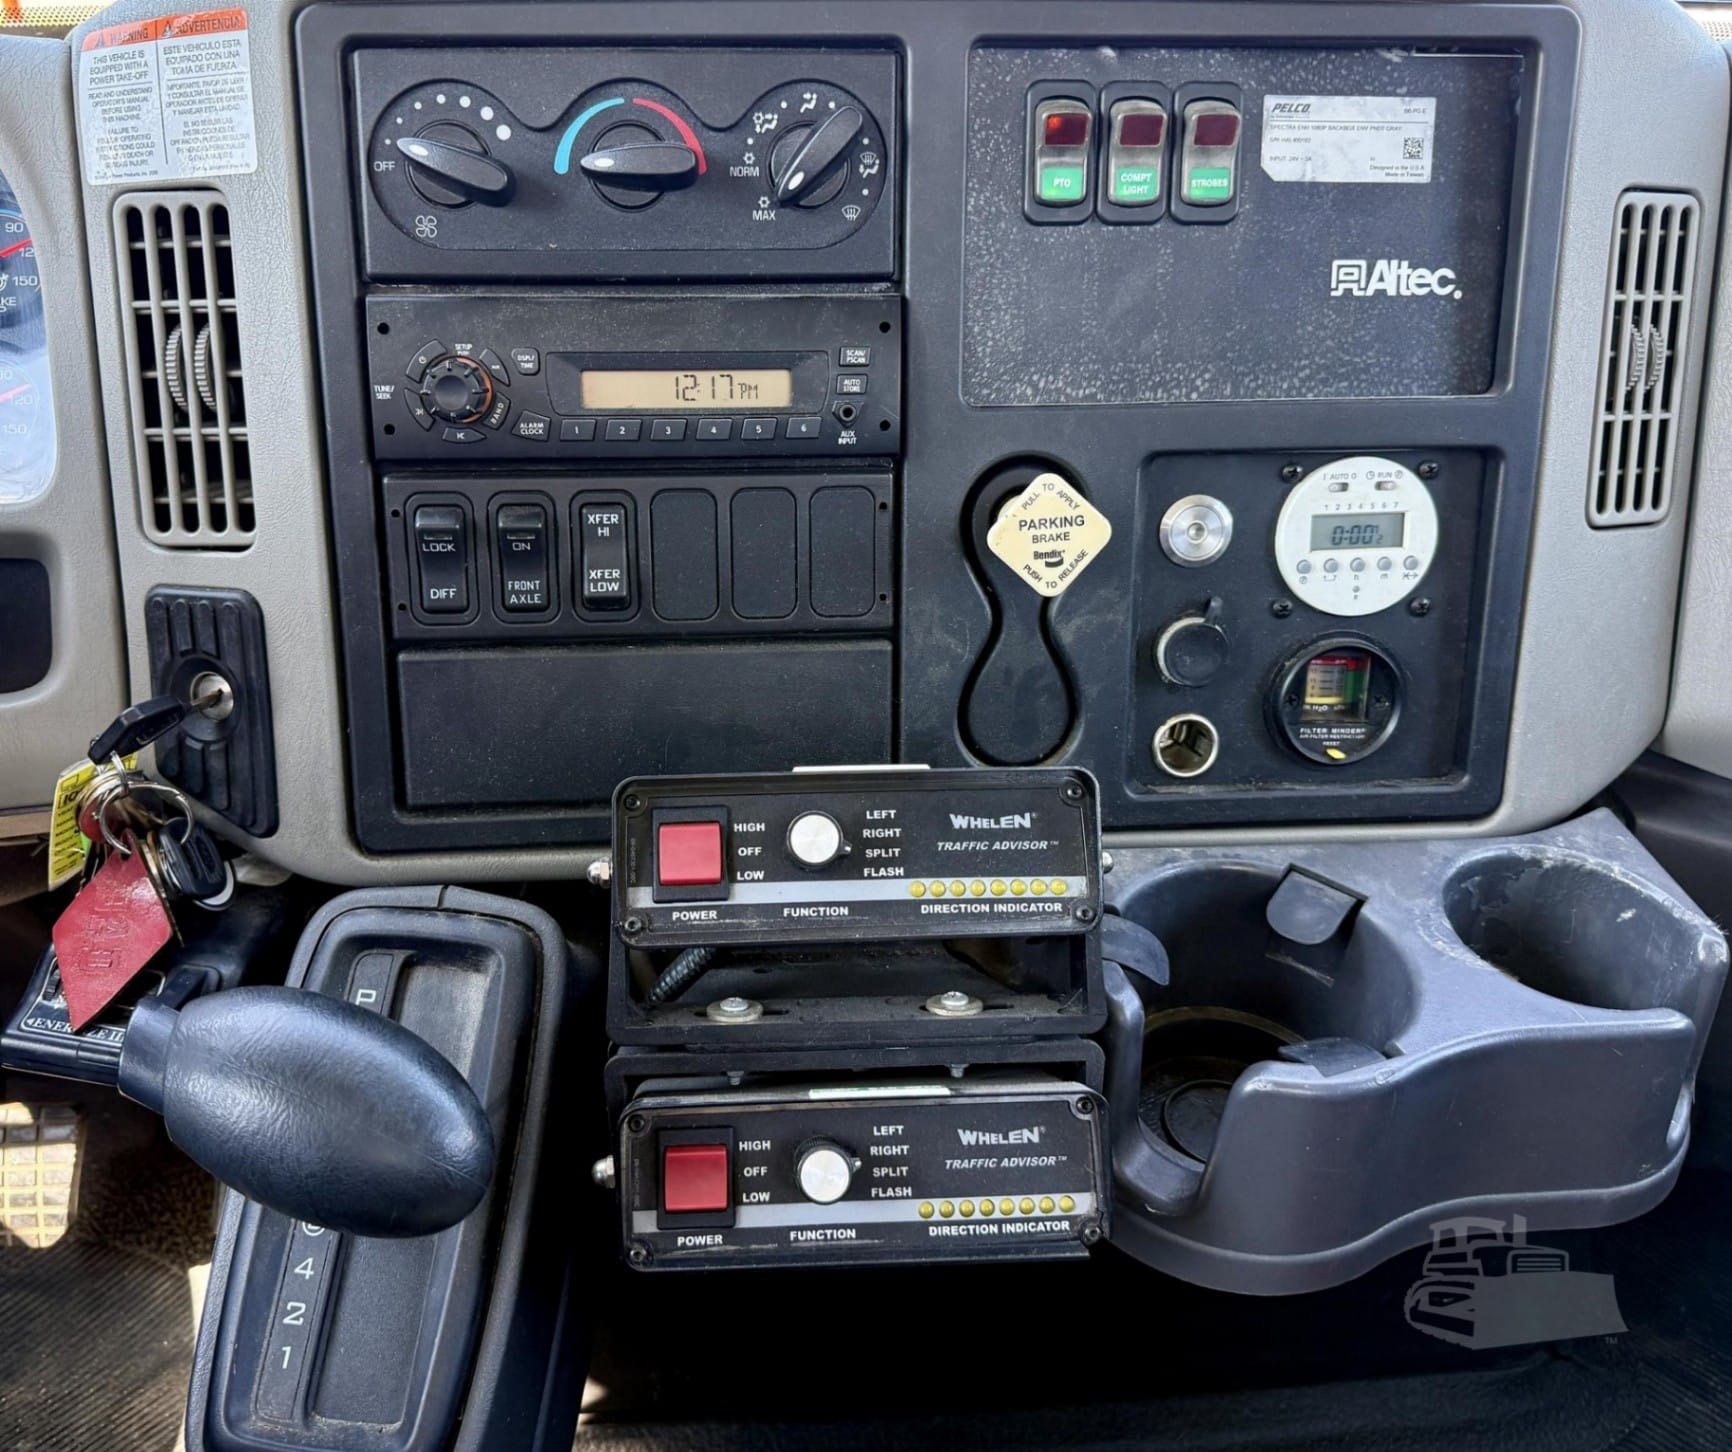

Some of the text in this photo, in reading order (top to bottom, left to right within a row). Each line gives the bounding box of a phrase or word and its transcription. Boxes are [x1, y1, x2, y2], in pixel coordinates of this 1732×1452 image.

[175, 16, 240, 35] ADVERTENCIA
[163, 39, 241, 55] ESTE VEHICULO ESTA
[94, 50, 145, 65] THIS VEHICLE IS
[166, 50, 241, 66] EQUIPADO CON UNA
[89, 60, 149, 76] EQUIPPED WITH A
[195, 65, 205, 73] DE
[207, 61, 237, 72] FUERZA
[89, 71, 149, 86] POWER TAKE-OFF
[1271, 103, 1311, 113] PELCO
[374, 161, 395, 172] OFF
[730, 167, 759, 177] NORM
[1053, 177, 1072, 188] PTO
[1121, 173, 1152, 182] COMPT
[1191, 178, 1228, 188] STROBES
[1123, 184, 1150, 195] LIGHT
[753, 210, 776, 220] MAX
[5, 222, 24, 233] 90
[19, 247, 34, 257] 12
[12, 275, 38, 286] 150
[0, 296, 17, 306] KE
[374, 385, 394, 393] TUNE/
[675, 374, 758, 402] 12:17 PM
[375, 392, 391, 400] SEEK
[490, 402, 504, 425] BAND
[574, 424, 807, 434] 1 2 3 4 5 6
[840, 430, 855, 438] AUX
[838, 437, 857, 445] INPUT
[1329, 473, 1349, 481] AUTO
[1377, 471, 1393, 479] RUN
[1022, 483, 1081, 511] PULL TO APPLY
[587, 513, 619, 525] XFER
[1018, 515, 1085, 531] PARKING
[598, 527, 610, 537] HI
[1032, 532, 1070, 544] BRAKE
[422, 543, 456, 552] LOCK
[512, 542, 531, 551] ON
[1033, 549, 1062, 560] Bendix
[589, 569, 620, 579] XFER
[1023, 548, 1089, 589] PUSH TO RELEASE
[508, 581, 541, 591] FRONT
[590, 582, 620, 592] LOW
[430, 588, 457, 599] DIFF
[510, 594, 542, 604] AXLE
[866, 810, 897, 820] LEFT
[734, 822, 765, 832] HIGH
[862, 828, 901, 838] RIGHT
[936, 840, 1048, 852] TRAFFIC ADVISOR
[738, 847, 762, 857] OFF
[865, 848, 901, 858] SPLIT
[736, 871, 764, 880] LOW
[863, 867, 904, 877] FLASH
[783, 906, 849, 918] FUNCTION
[921, 902, 1063, 914] DIRECTION INDICATOR
[672, 910, 718, 921] POWER
[355, 989, 377, 1005] P
[873, 1126, 904, 1136] LEFT
[739, 1140, 771, 1151] HIGH
[870, 1145, 910, 1156] RIGHT
[945, 1156, 1057, 1170] TRAFFIC ADVISOR
[743, 1166, 767, 1177] OFF
[872, 1166, 909, 1177] SPLIT
[743, 1192, 770, 1202] LOW
[871, 1187, 912, 1198] FLASH
[928, 1221, 1070, 1236] DIRECTION INDICATOR
[677, 1234, 723, 1246] POWER
[790, 1228, 856, 1241] FUNCTION
[293, 1257, 315, 1279] 4
[282, 1302, 306, 1326] 2
[281, 1346, 292, 1370] 1
